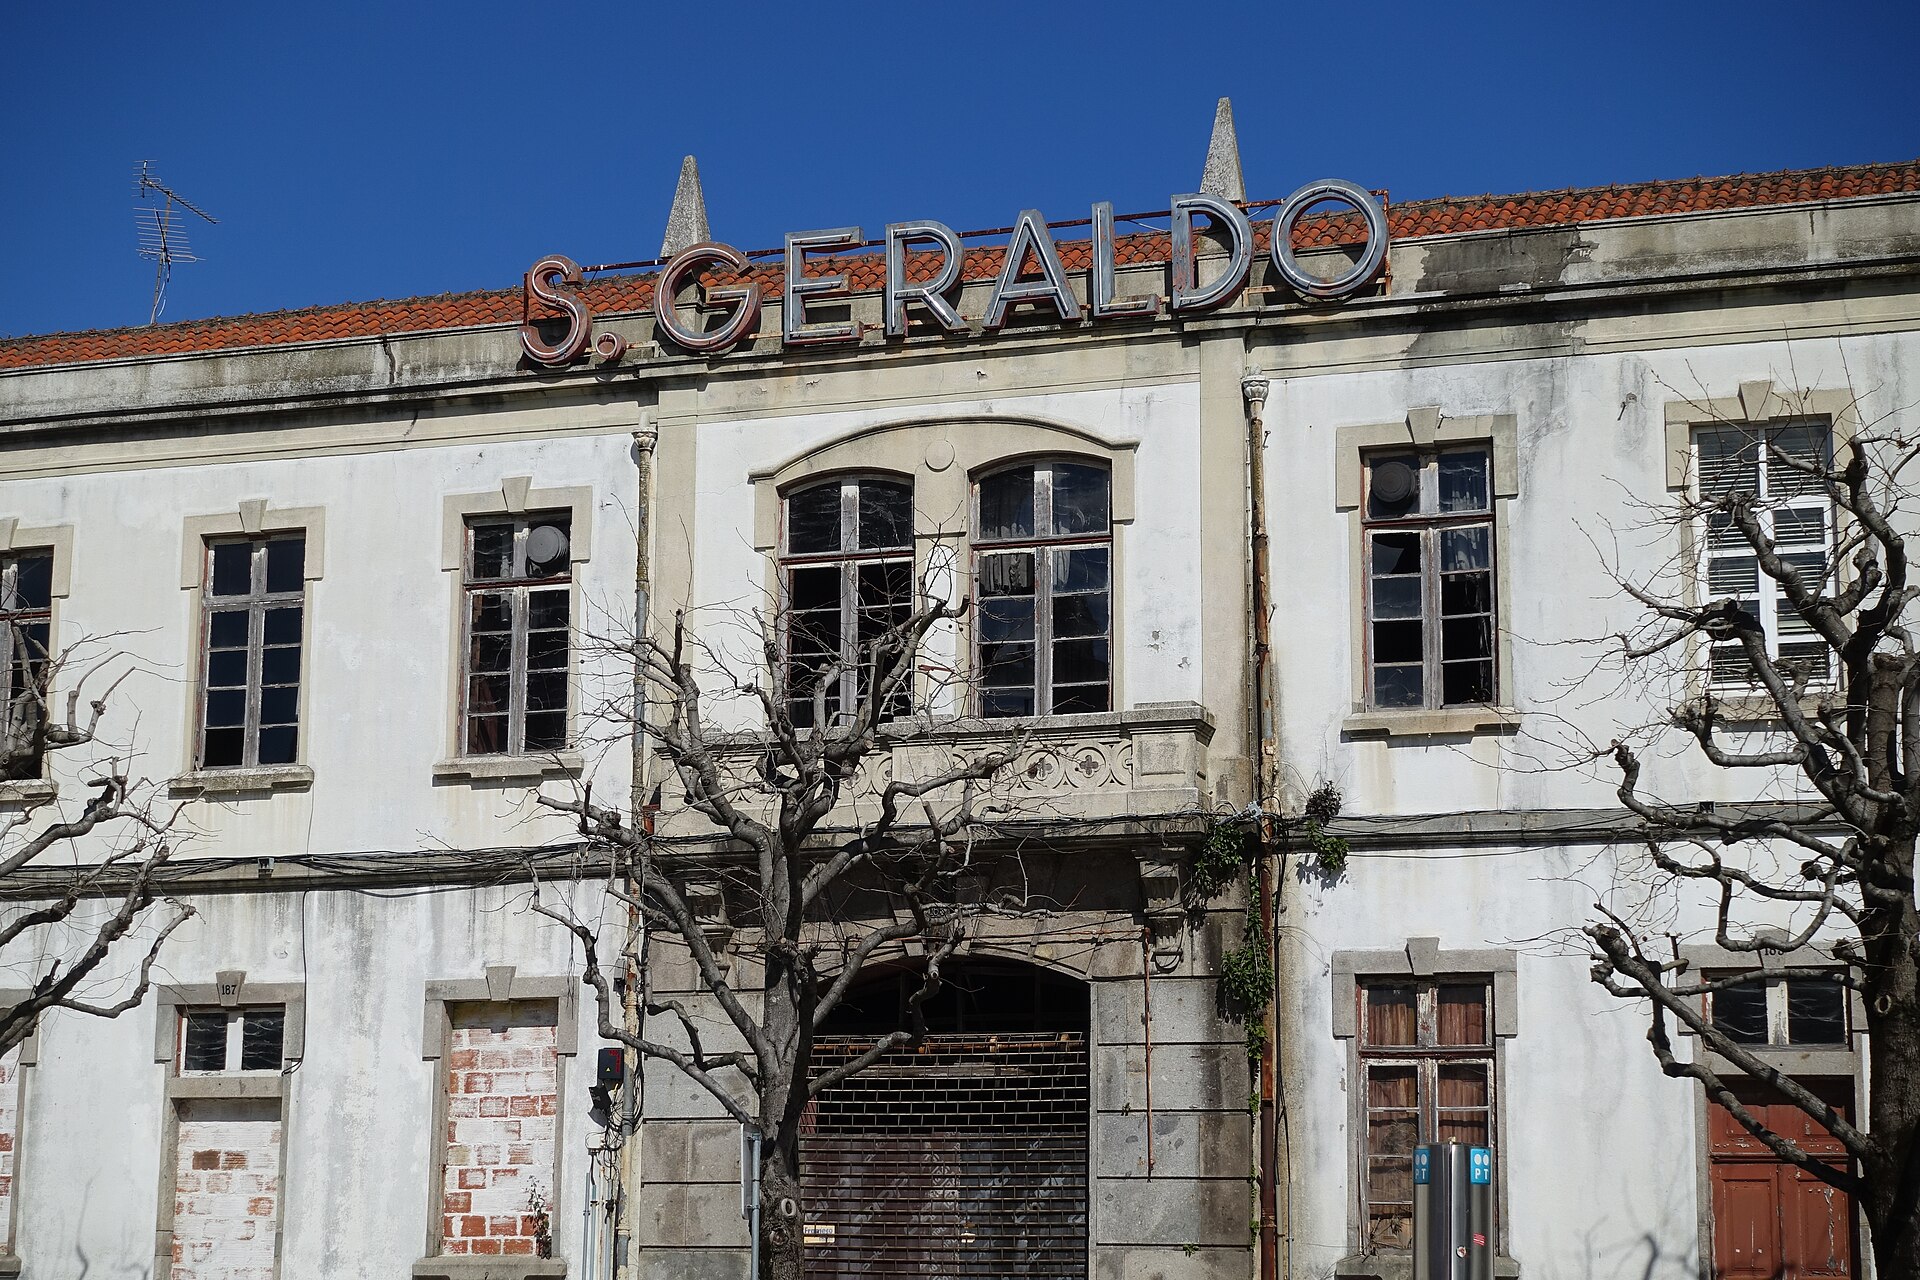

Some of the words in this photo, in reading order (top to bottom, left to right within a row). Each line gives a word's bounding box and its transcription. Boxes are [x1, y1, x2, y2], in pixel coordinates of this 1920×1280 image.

[517, 254, 627, 364] S.
[654, 178, 1388, 352] GERALDO
[221, 984, 237, 995] 187
[1415, 1168, 1427, 1180] PT
[1474, 1168, 1489, 1180] PT
